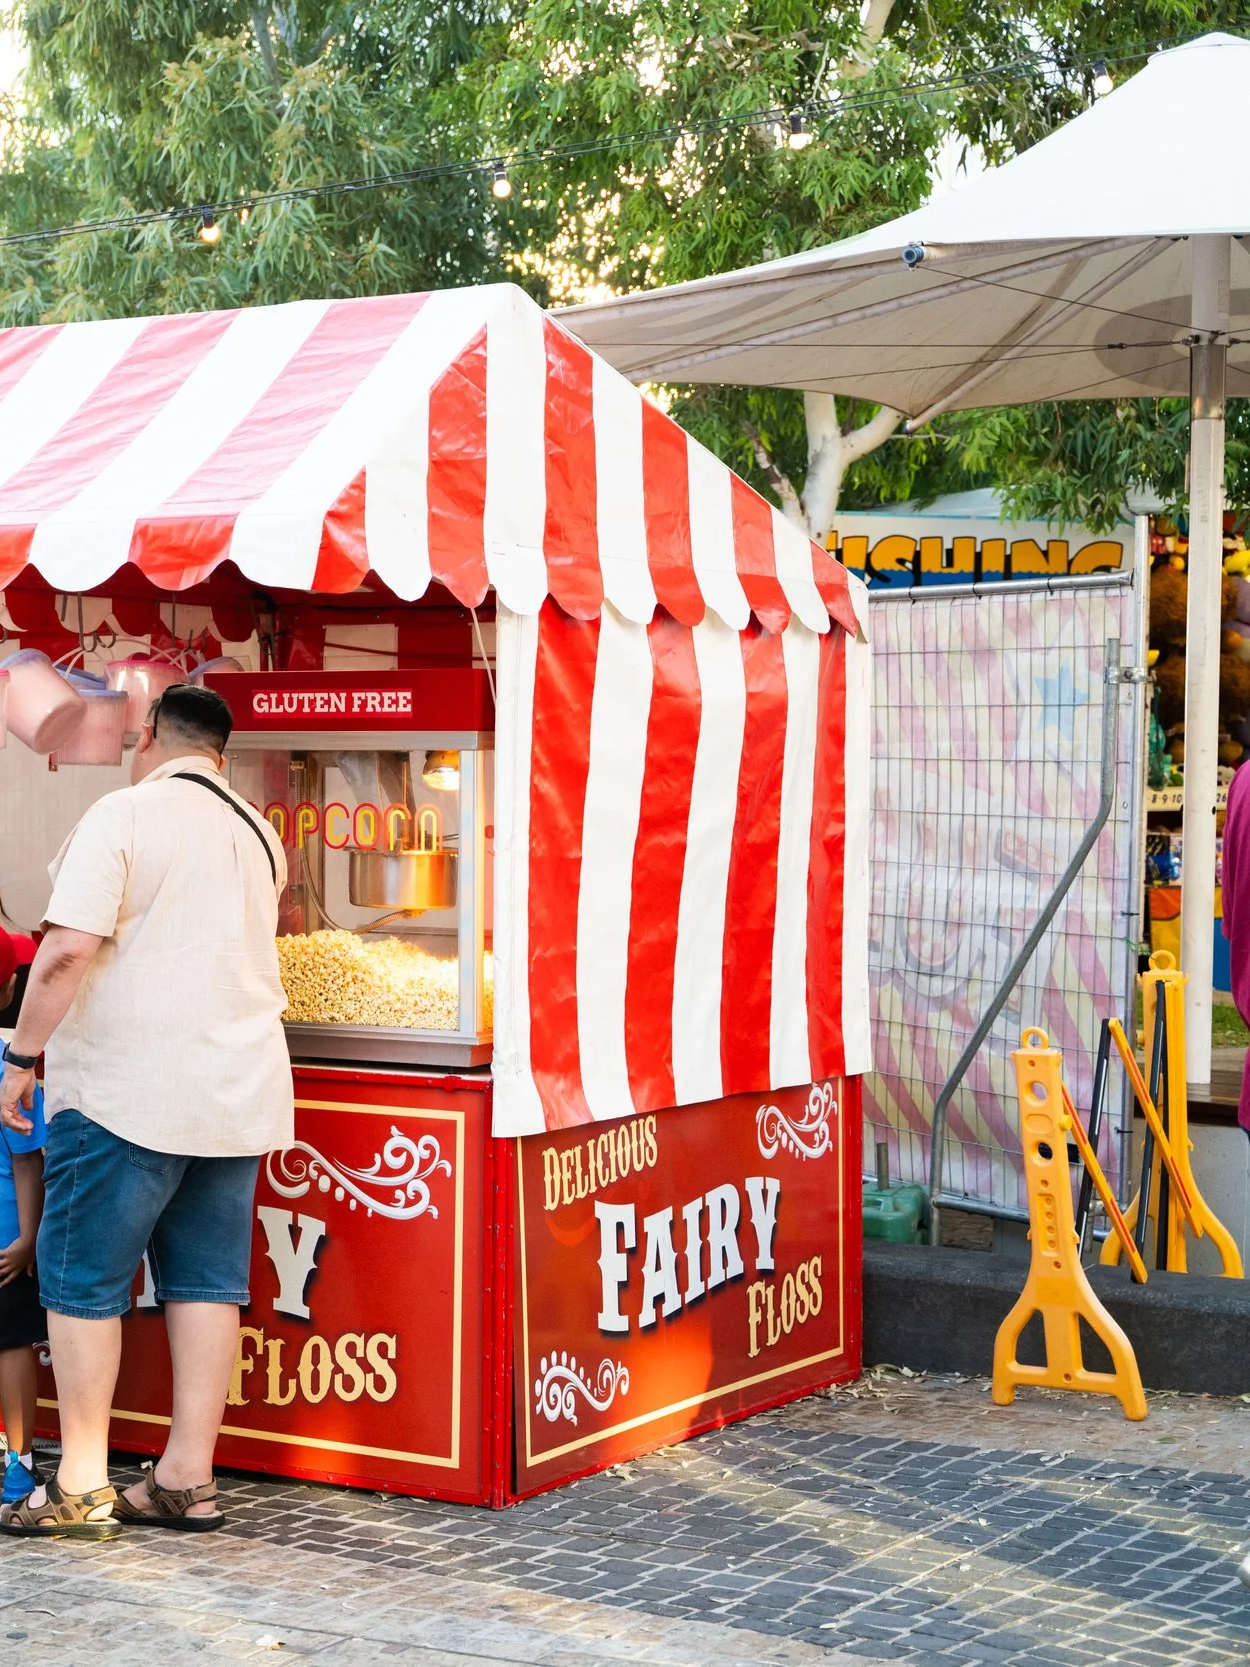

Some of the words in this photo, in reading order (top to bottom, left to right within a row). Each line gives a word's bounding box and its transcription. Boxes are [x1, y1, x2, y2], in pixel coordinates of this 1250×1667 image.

[252, 692, 346, 713] GLUTEN
[352, 691, 412, 712] FREE
[542, 1115, 658, 1211] DELICIOUS
[595, 1177, 780, 1332] FAIRY
[748, 1256, 822, 1358] FLOSS
[225, 1326, 397, 1406] FLOSS
